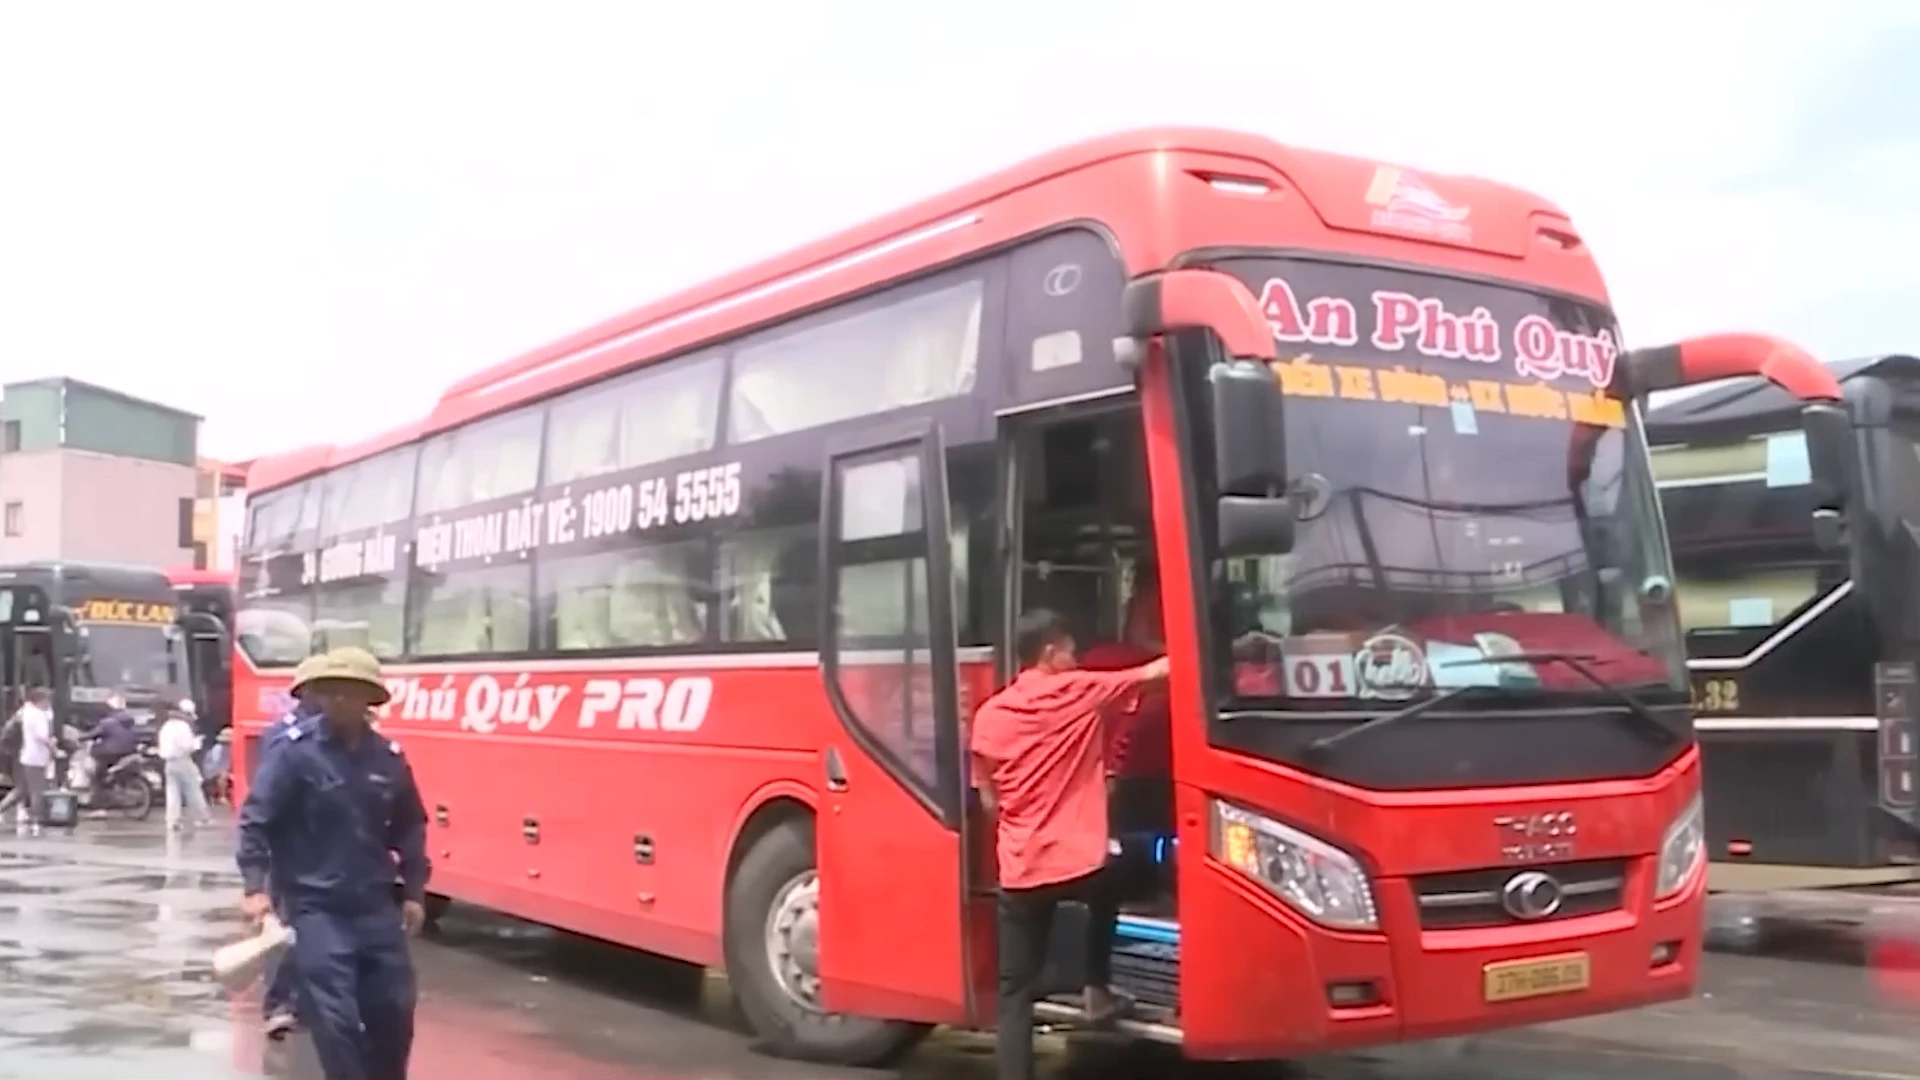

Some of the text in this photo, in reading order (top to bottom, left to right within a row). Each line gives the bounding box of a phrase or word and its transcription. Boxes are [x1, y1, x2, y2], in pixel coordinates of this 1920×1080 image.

[1262, 278, 1617, 388] An Phú Quý
[454, 512, 503, 563] THOẠI
[582, 484, 633, 539] 1900
[637, 477, 668, 530] 54
[674, 462, 742, 524] 5555
[577, 677, 714, 731] PRO
[1294, 660, 1348, 694] 01
